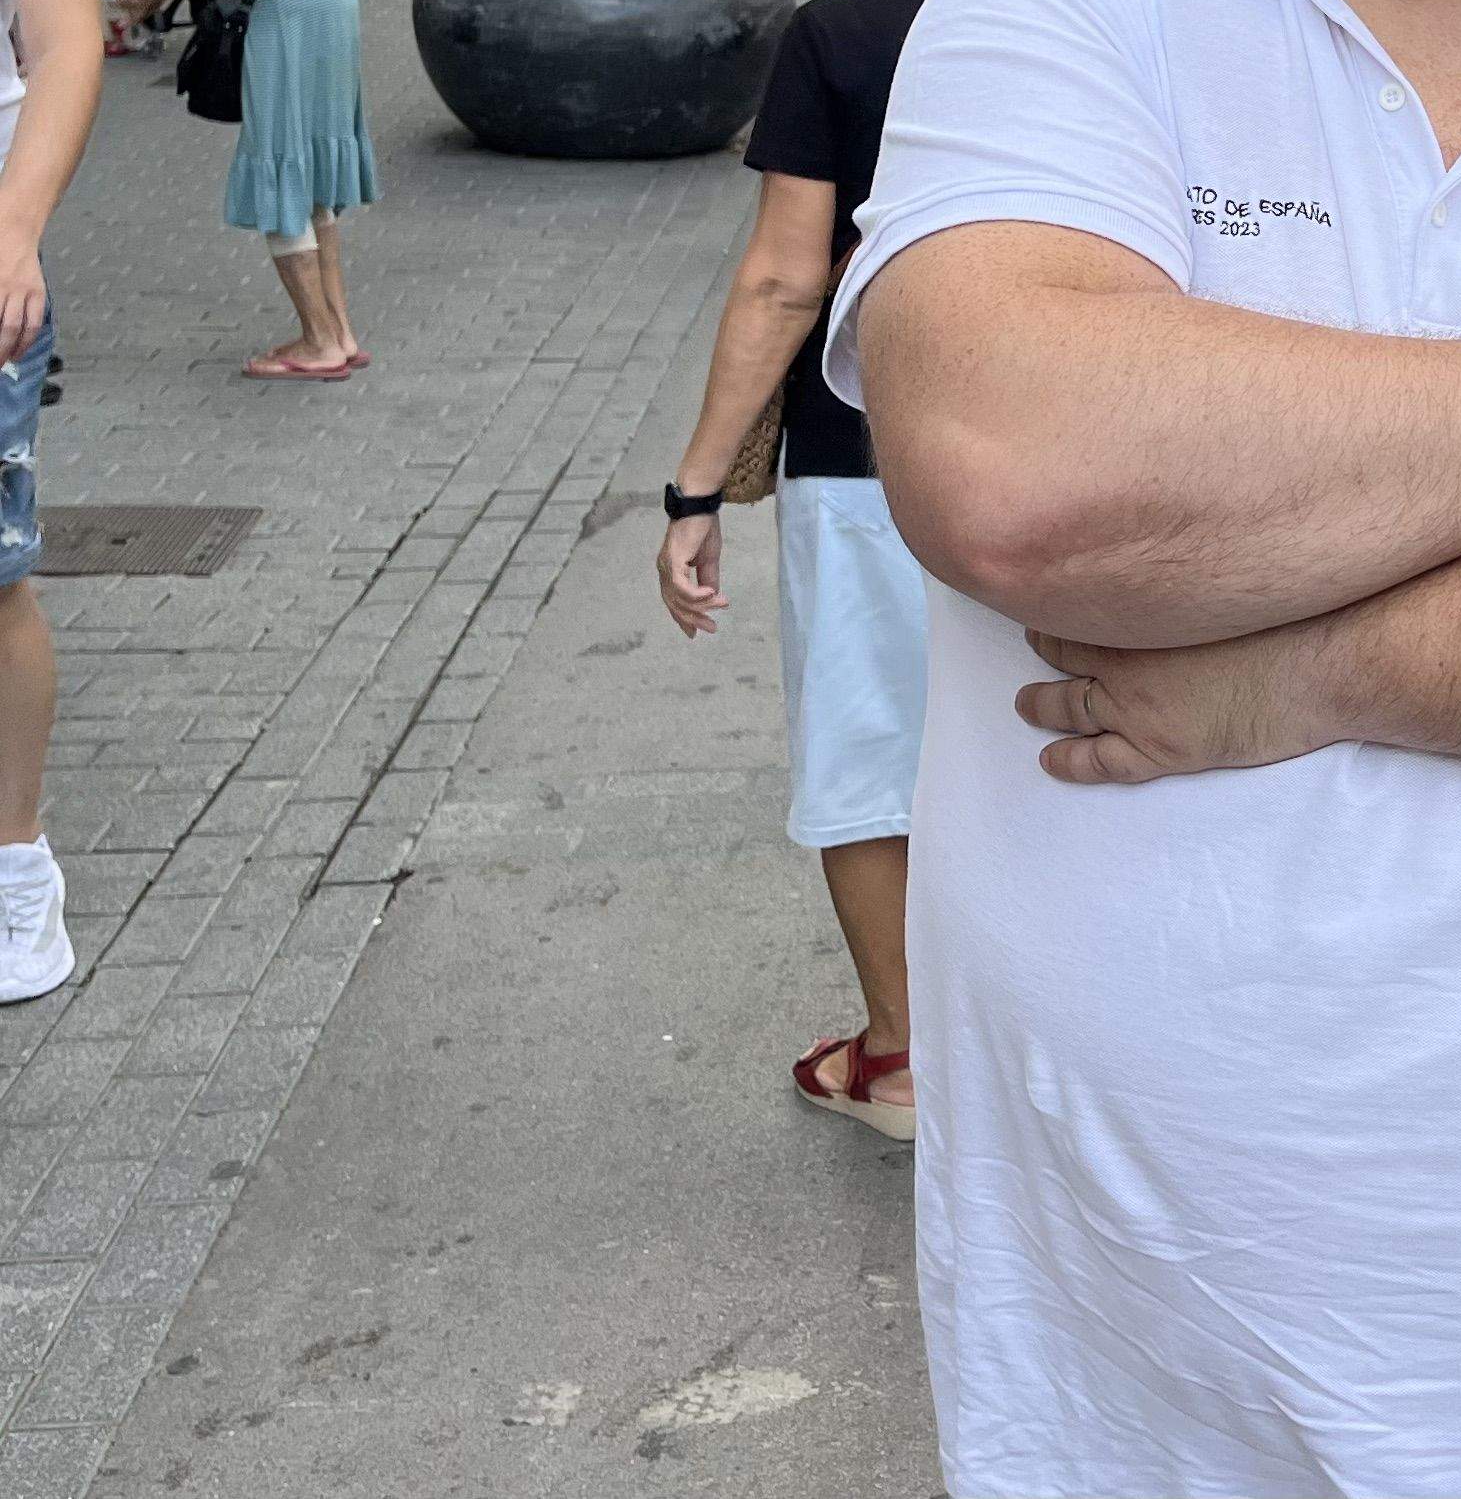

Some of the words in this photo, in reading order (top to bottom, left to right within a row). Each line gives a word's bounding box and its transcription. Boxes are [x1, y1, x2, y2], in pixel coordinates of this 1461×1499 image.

[1225, 199, 1251, 218] DE
[1259, 199, 1331, 227] ESPAÑA
[1220, 220, 1260, 236] 2023
